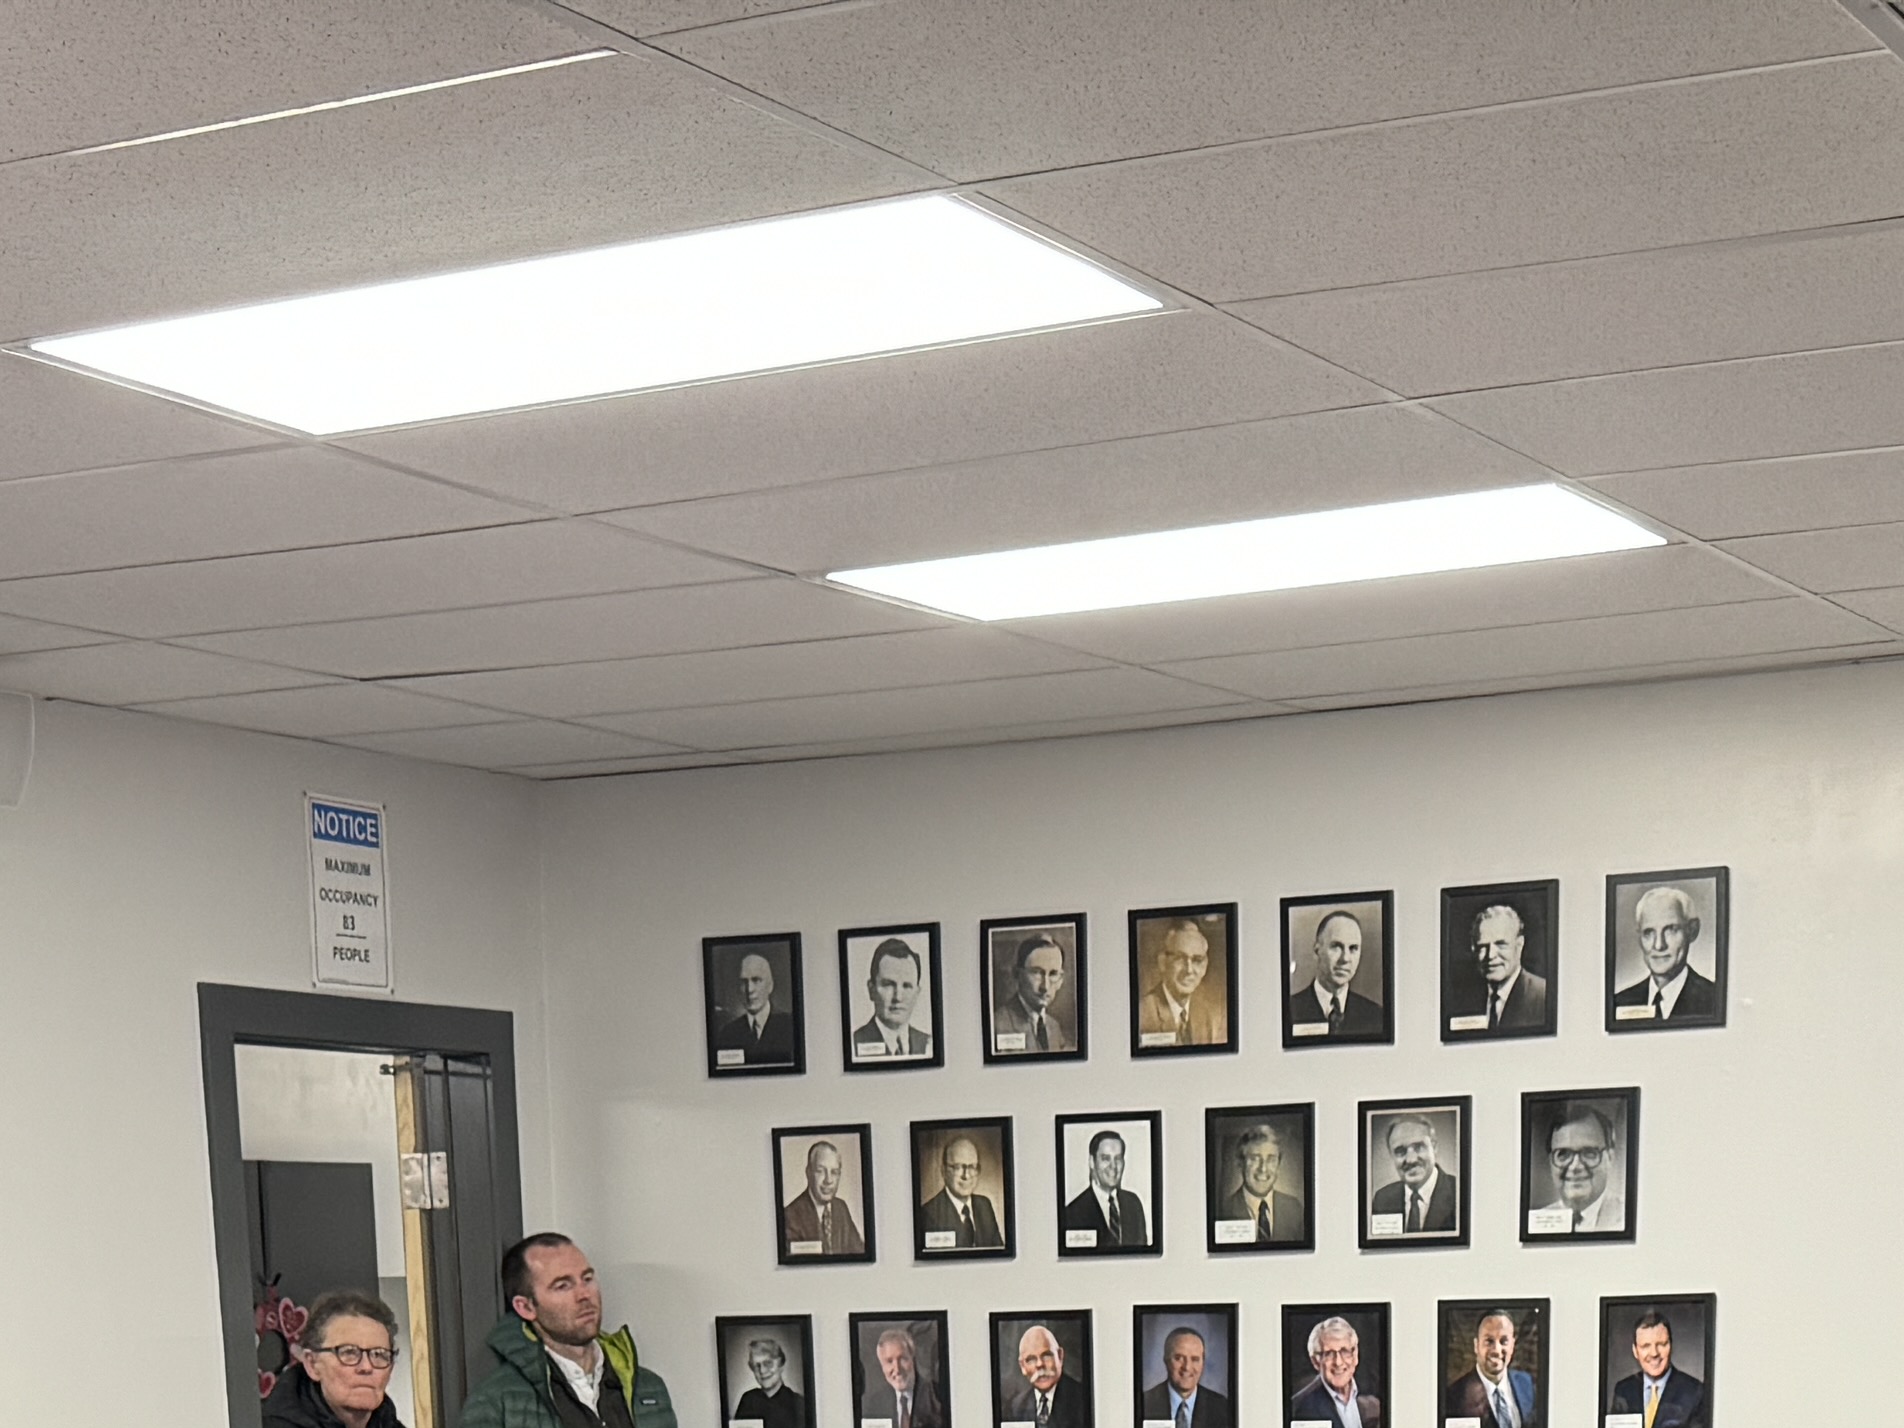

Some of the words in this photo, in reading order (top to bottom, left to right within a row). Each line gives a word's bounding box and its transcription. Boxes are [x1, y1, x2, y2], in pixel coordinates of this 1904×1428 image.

[313, 809, 378, 843] NOTICE
[324, 857, 371, 877] MAXIMUM
[319, 887, 379, 908] OCCUPANCY
[342, 915, 356, 931] 83
[332, 946, 371, 963] PEOPLE
